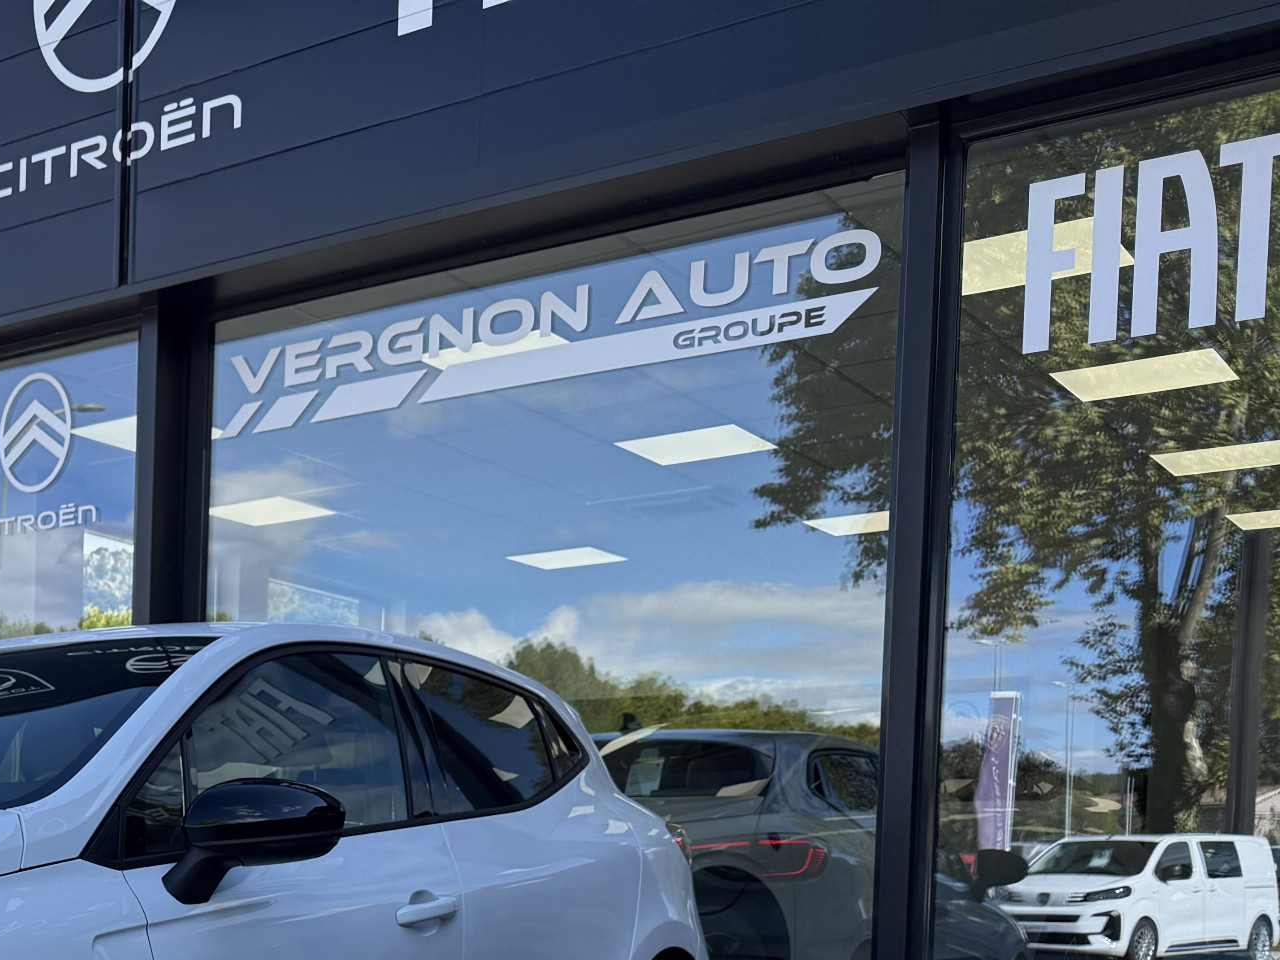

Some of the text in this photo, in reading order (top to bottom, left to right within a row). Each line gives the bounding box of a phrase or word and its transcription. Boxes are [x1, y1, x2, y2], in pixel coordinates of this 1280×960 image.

[230, 229, 882, 394] VERGNON AUTO
[1022, 133, 1280, 354] FIAT
[672, 305, 826, 350] GROUPE
